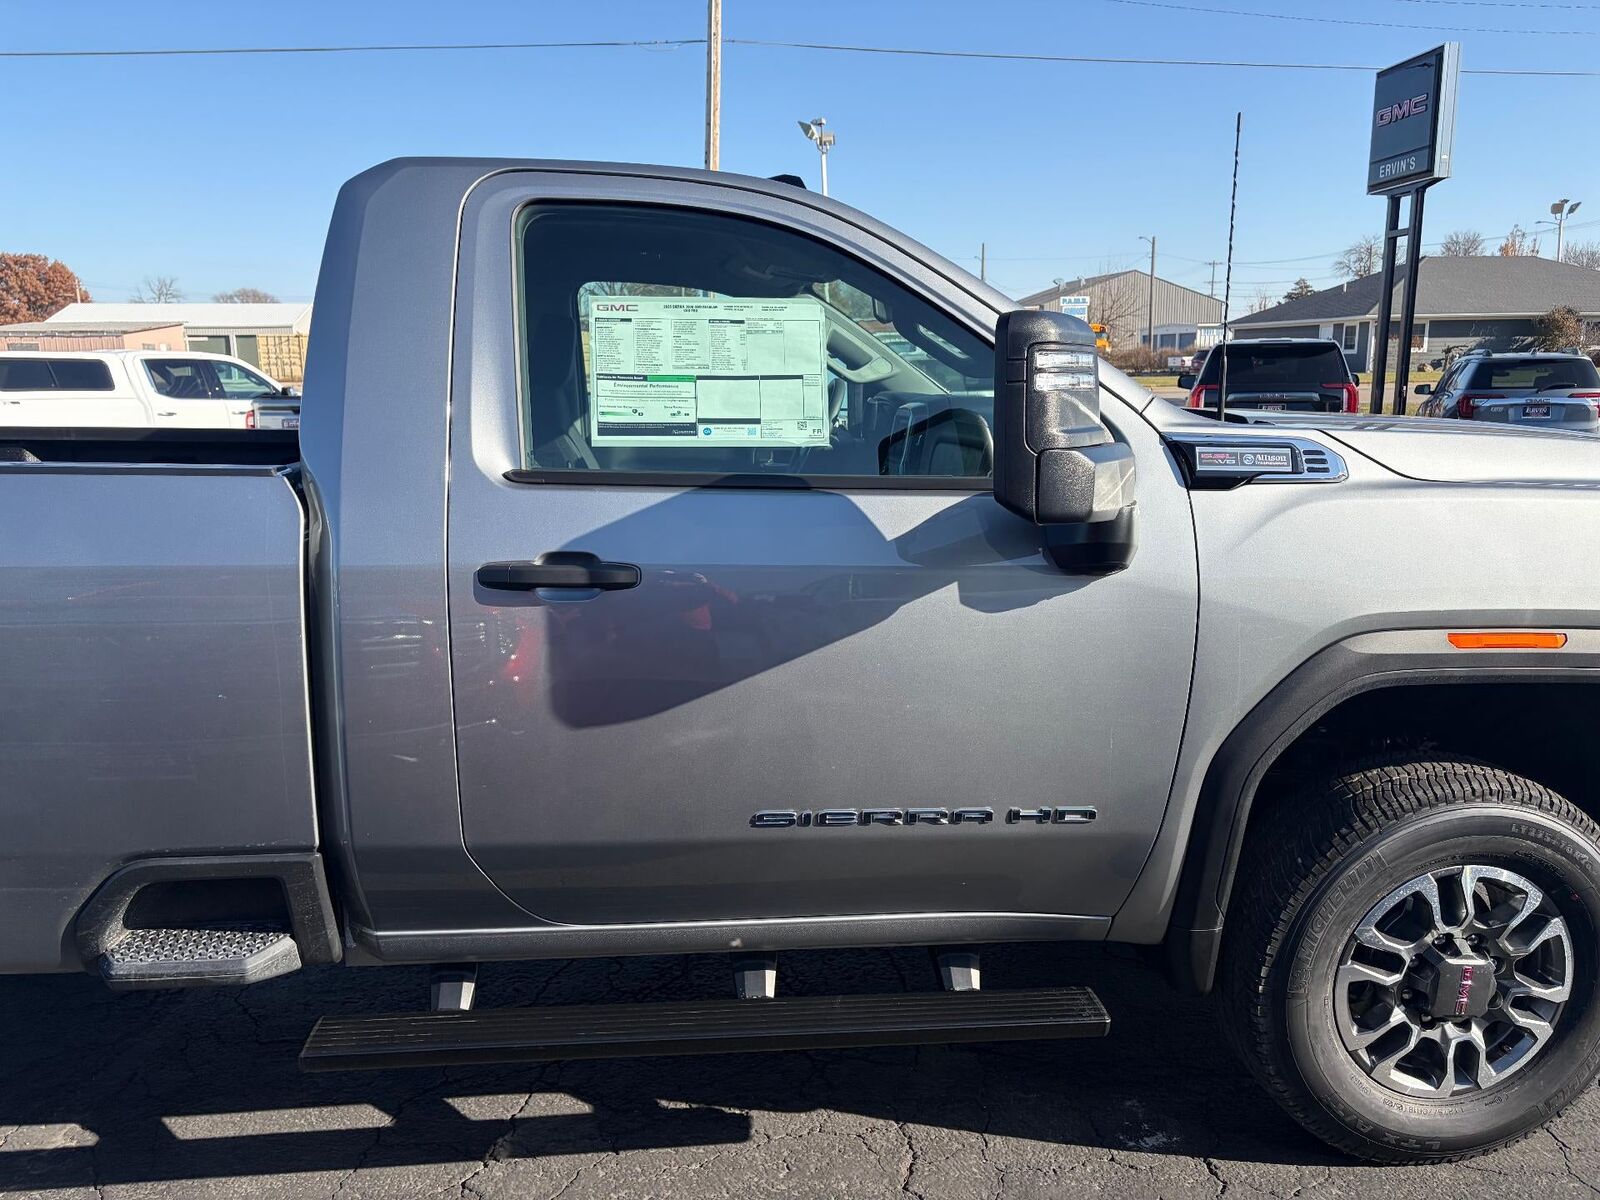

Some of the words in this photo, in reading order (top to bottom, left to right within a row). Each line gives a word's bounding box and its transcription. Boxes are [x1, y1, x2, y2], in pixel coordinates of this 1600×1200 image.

[1376, 94, 1428, 126] GMC
[1379, 156, 1416, 178] ERVIN'S
[596, 304, 639, 312] GMC
[1255, 454, 1287, 462] Allison
[749, 807, 995, 828] SIERRA
[1005, 805, 1098, 825] HD
[1297, 854, 1380, 964] MICHELIN
[1455, 966, 1474, 1015] GMC
[1381, 1133, 1441, 1150] LTX
